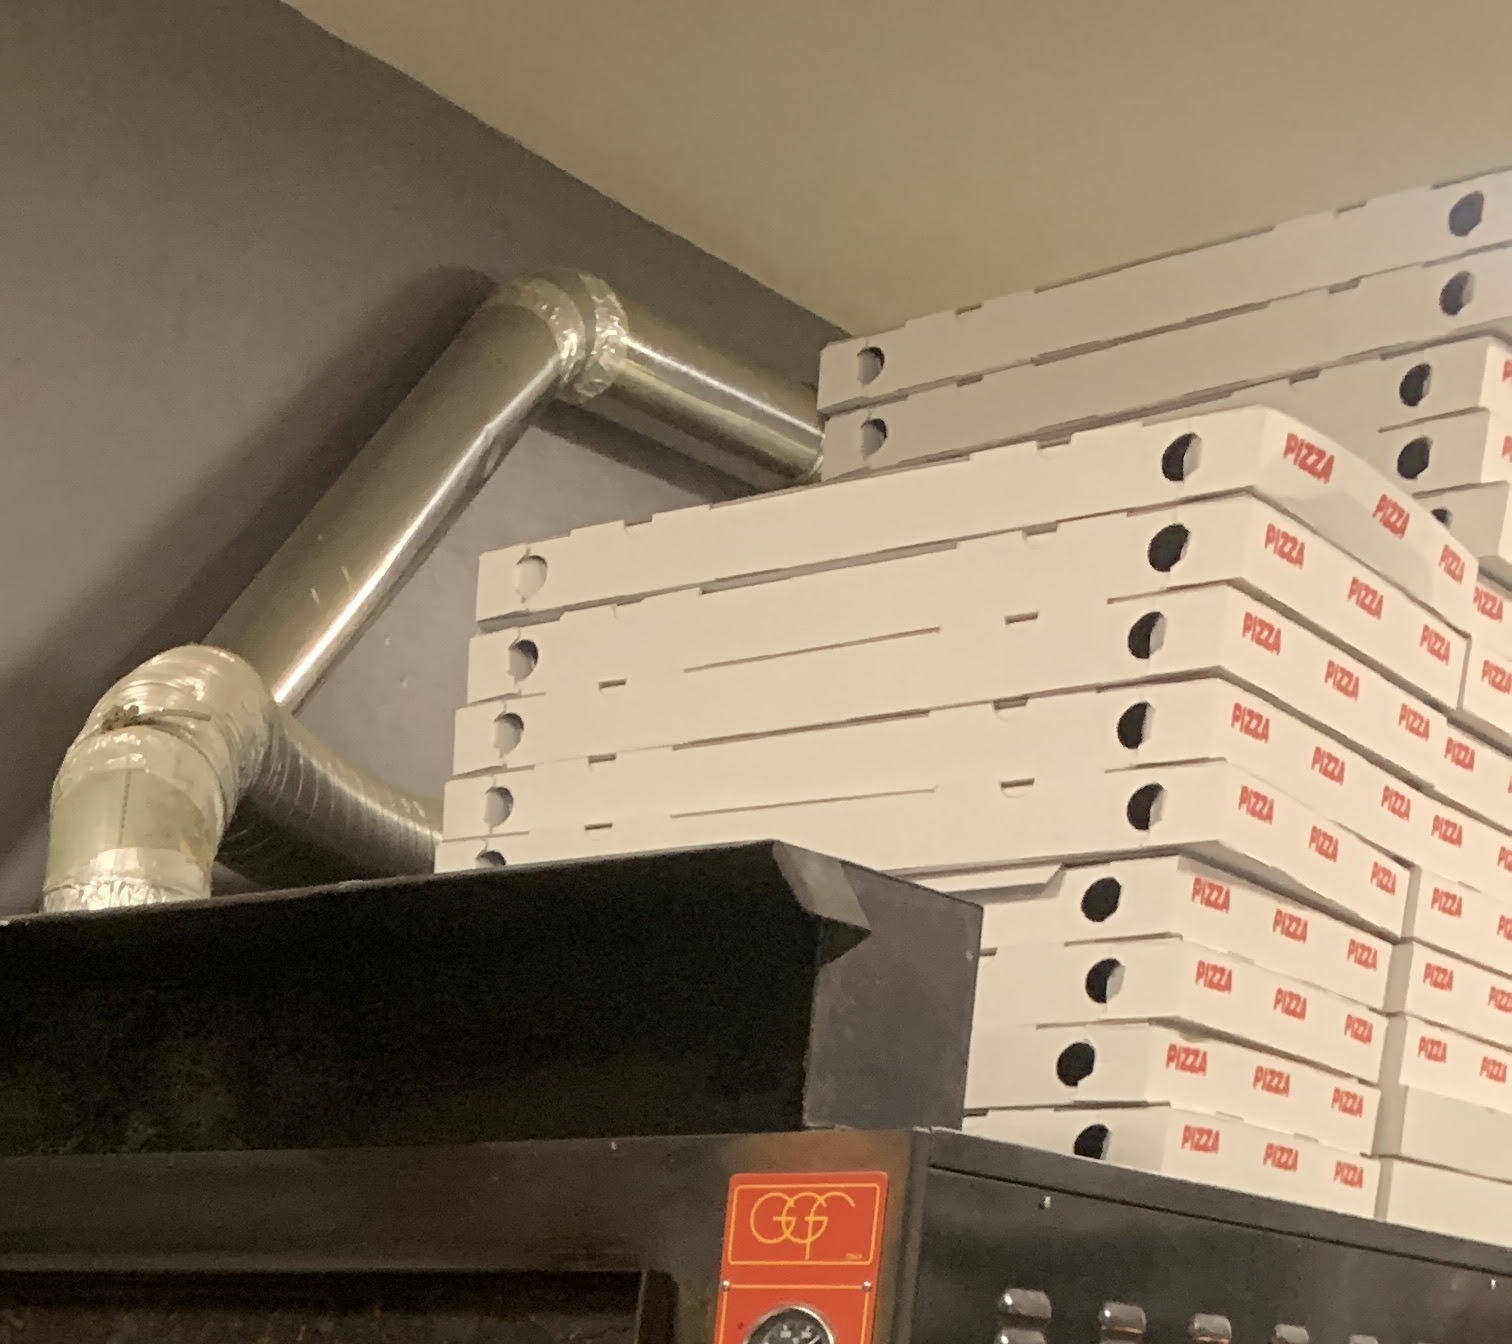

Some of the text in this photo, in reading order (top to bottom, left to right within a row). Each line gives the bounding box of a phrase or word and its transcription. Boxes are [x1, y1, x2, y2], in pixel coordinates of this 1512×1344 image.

[1283, 432, 1465, 584] PIZZA PIZZA PIZZA
[1264, 523, 1450, 665] PIZZA PIZZA PIZZA
[1241, 612, 1431, 742] PIZZA PIZZA PIZZA
[1230, 702, 1412, 822] PIZZA PIZZA PIZZA
[1444, 737, 1476, 772] PIZZA
[1238, 784, 1397, 897] PIZZA PIZZA PIZZA
[1431, 814, 1464, 848] PIZZA
[1191, 876, 1379, 971] PIZZA PIZZA PIZZA
[1431, 887, 1463, 919] PIZZA
[1195, 959, 1373, 1046] PIZZA PIZZA PIZZA
[1423, 962, 1454, 993] PIZZA
[1165, 1043, 1364, 1119] PIZZA PIZZA PIZZA
[1417, 1035, 1508, 1085] PIZZA PIZZA
[1181, 1125, 1364, 1190] PIZZA PIZZA PIZZA
